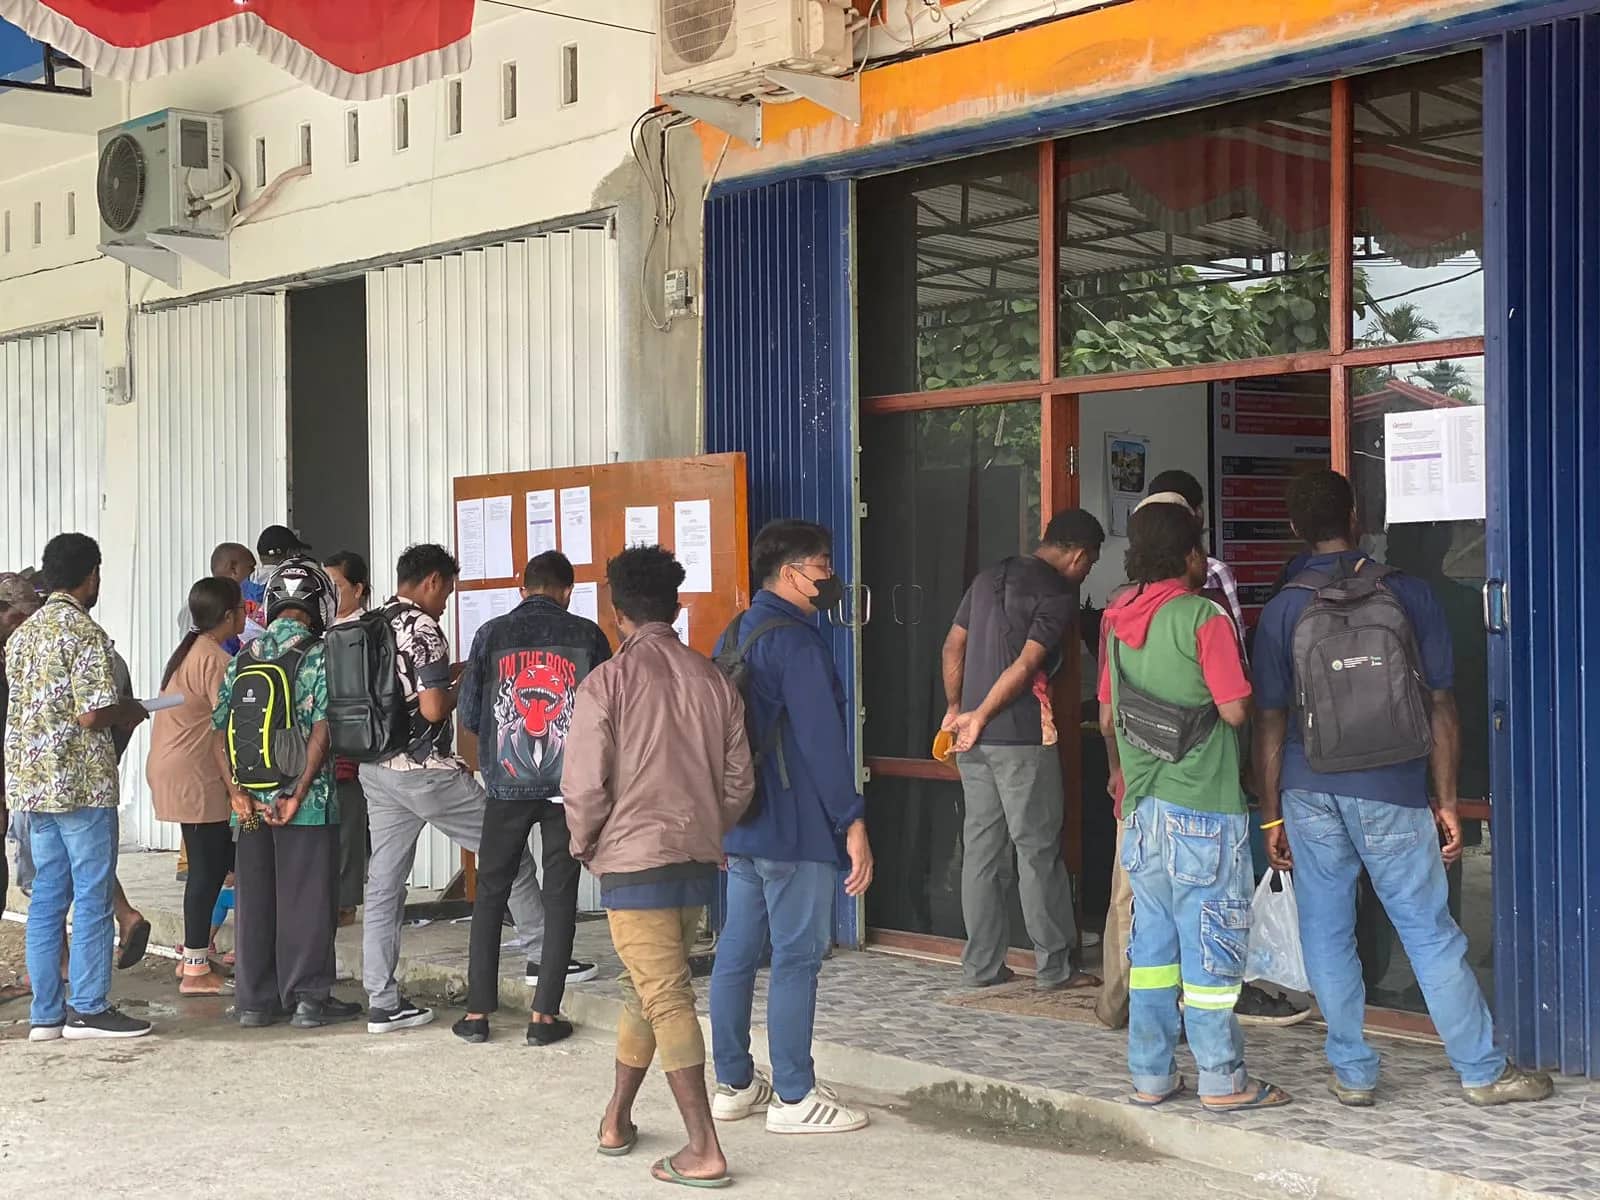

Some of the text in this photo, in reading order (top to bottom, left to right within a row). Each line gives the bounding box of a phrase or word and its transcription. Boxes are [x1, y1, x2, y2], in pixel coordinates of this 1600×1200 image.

[499, 651, 576, 687] I'M THE BOSS
